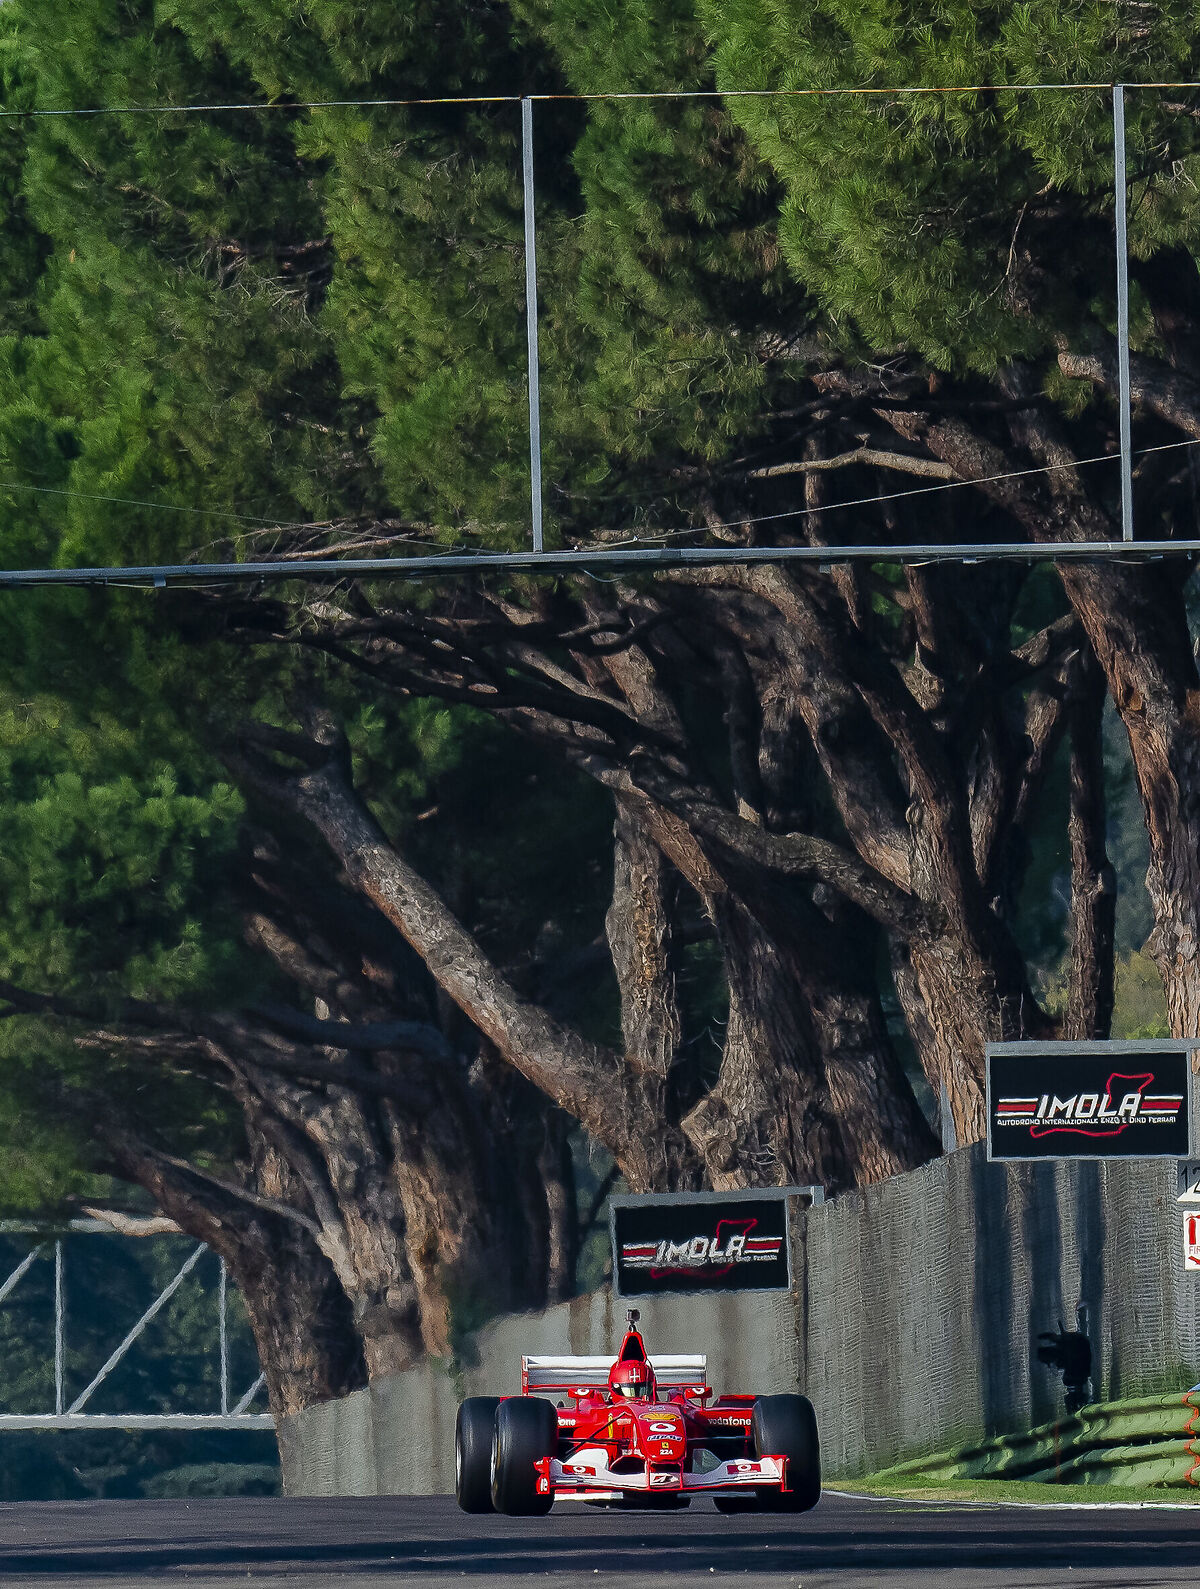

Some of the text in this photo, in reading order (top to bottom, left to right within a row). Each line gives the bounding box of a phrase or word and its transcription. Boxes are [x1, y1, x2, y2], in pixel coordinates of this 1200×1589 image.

[1036, 1093, 1142, 1119] IMOLA
[1042, 1117, 1099, 1125] INTERNAZIONALE
[655, 1234, 746, 1263] IMOLA
[707, 1416, 752, 1427] vodafone
